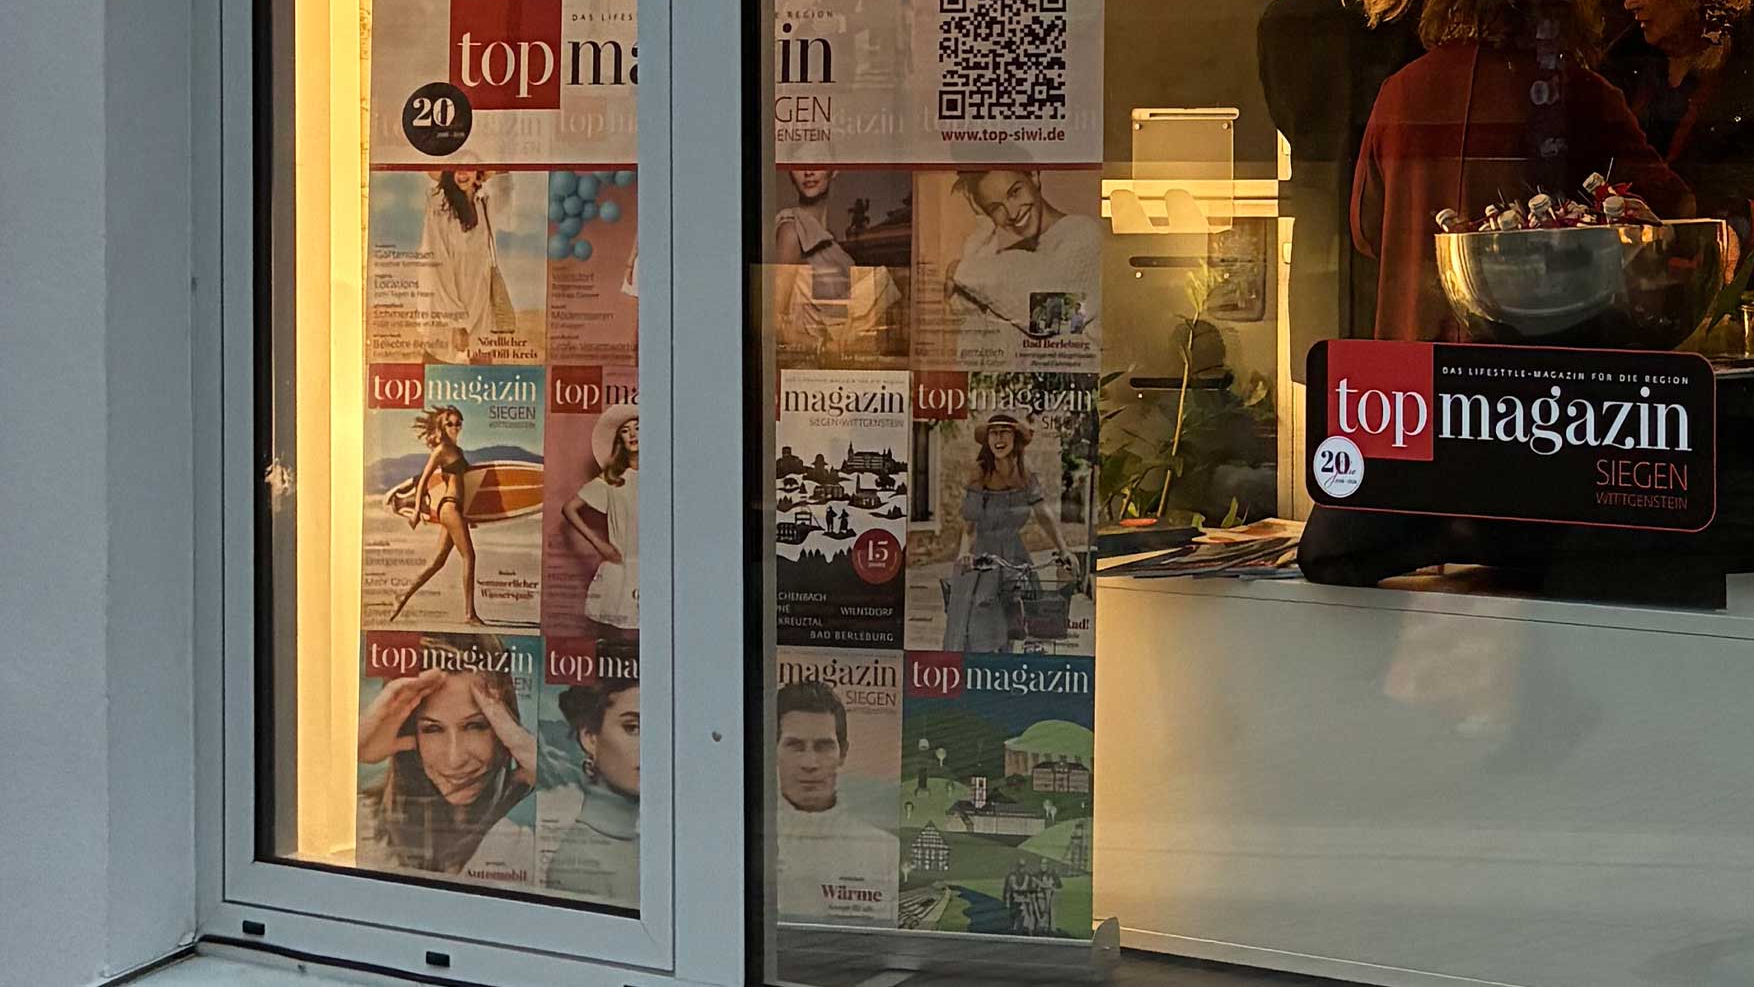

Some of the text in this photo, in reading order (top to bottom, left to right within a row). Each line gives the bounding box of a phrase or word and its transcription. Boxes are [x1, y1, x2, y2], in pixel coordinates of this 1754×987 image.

[572, 13, 593, 22] DAS
[457, 31, 555, 98] top
[412, 97, 456, 127] 20
[941, 126, 1066, 145] www.top-siwi.de
[1023, 339, 1042, 349] Bad
[373, 374, 537, 405] top magazin
[1442, 366, 1463, 375] DAS
[1468, 367, 1585, 381] LIFESTYLE-MAGAZIN
[1619, 374, 1638, 383] DIE
[1644, 375, 1689, 385] REGION
[555, 378, 600, 408] top
[784, 384, 905, 417] magazin
[918, 382, 1092, 415] top magazin
[489, 405, 536, 420] SIEGEN
[1335, 377, 1693, 456] top magazin
[1320, 450, 1351, 475] 20
[1596, 459, 1688, 491] SIEGEN
[1596, 491, 1688, 510] WITTGENSTEIN
[867, 540, 890, 563] 15
[810, 630, 894, 642] BAD BERLEBURG
[371, 643, 533, 674] top magazin
[549, 648, 593, 681] top
[778, 659, 897, 688] magazin
[912, 660, 1089, 695] top magazin
[846, 690, 897, 706] SIEGEN
[821, 884, 882, 903] Wärme
